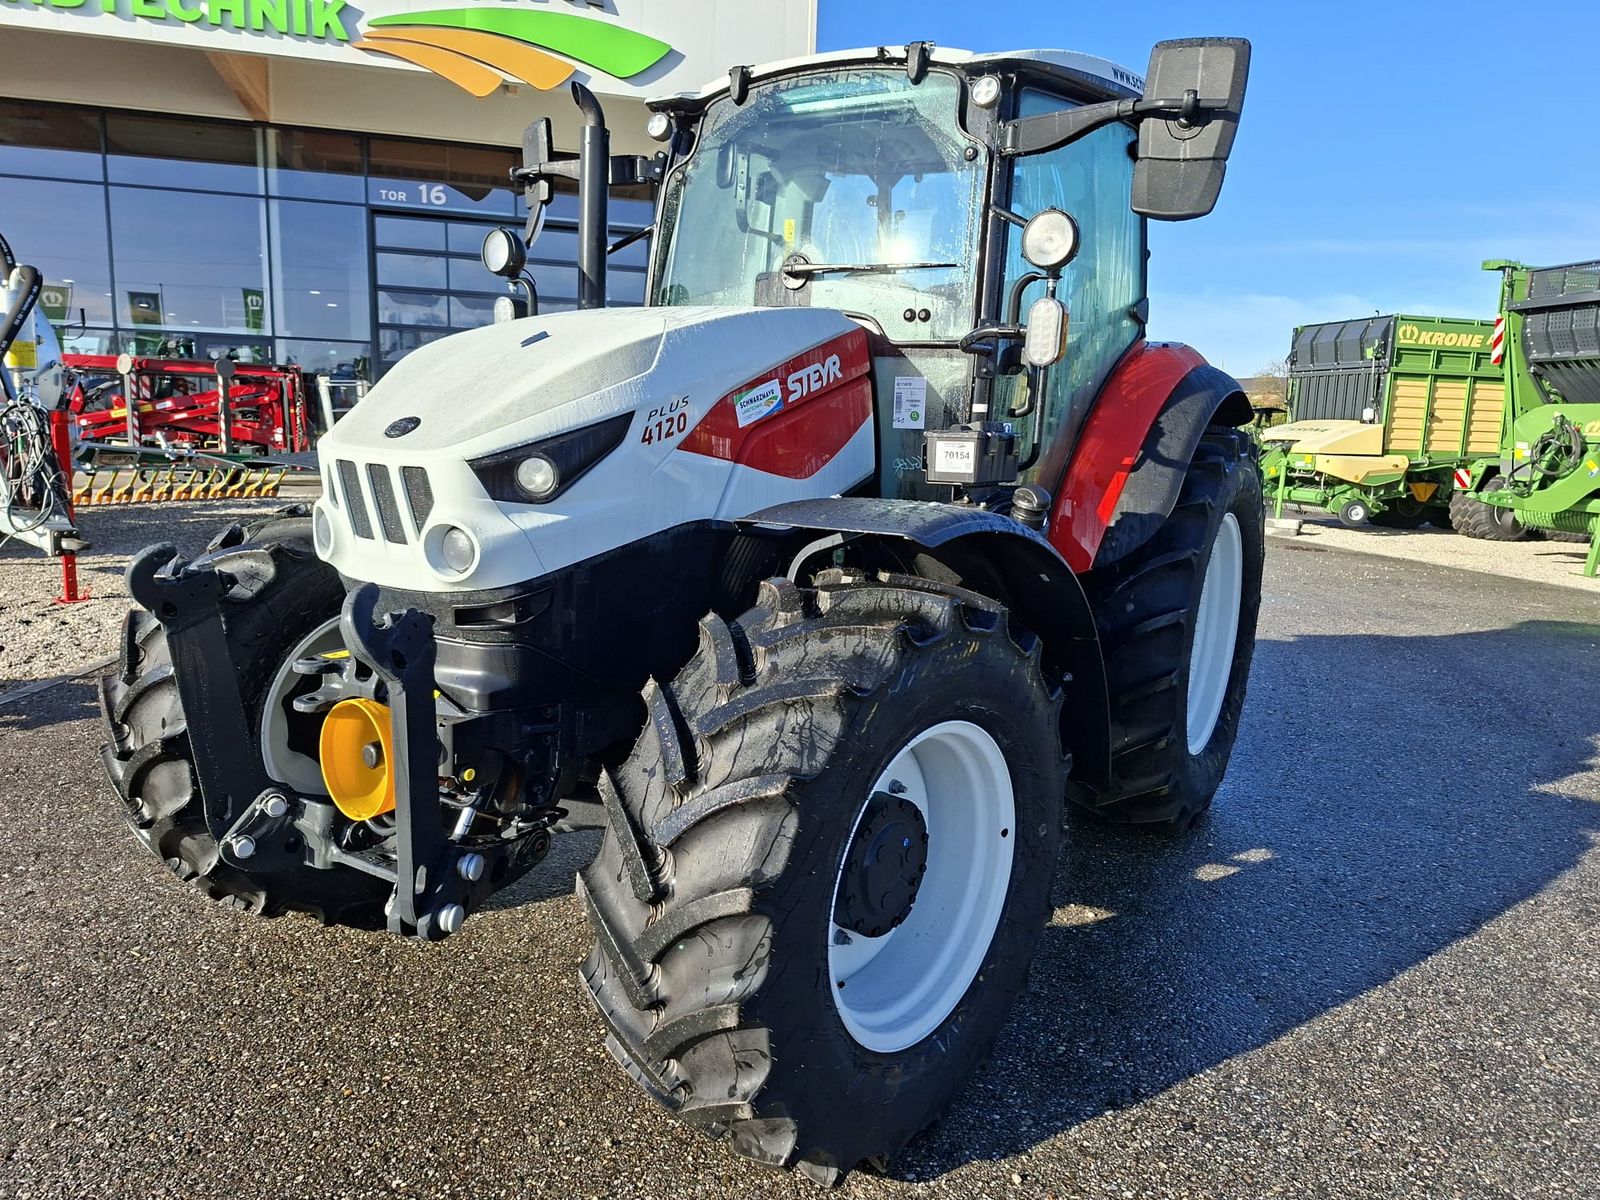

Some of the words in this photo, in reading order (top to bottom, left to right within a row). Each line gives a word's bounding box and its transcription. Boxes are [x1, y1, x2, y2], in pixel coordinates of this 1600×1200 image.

[379, 189, 407, 202] TOR
[418, 183, 447, 206] 16
[1418, 331, 1484, 348] KRONE
[787, 353, 843, 403] STEYR
[647, 395, 690, 422] PLUS
[641, 412, 687, 446] 4120
[944, 450, 970, 461] 70154
